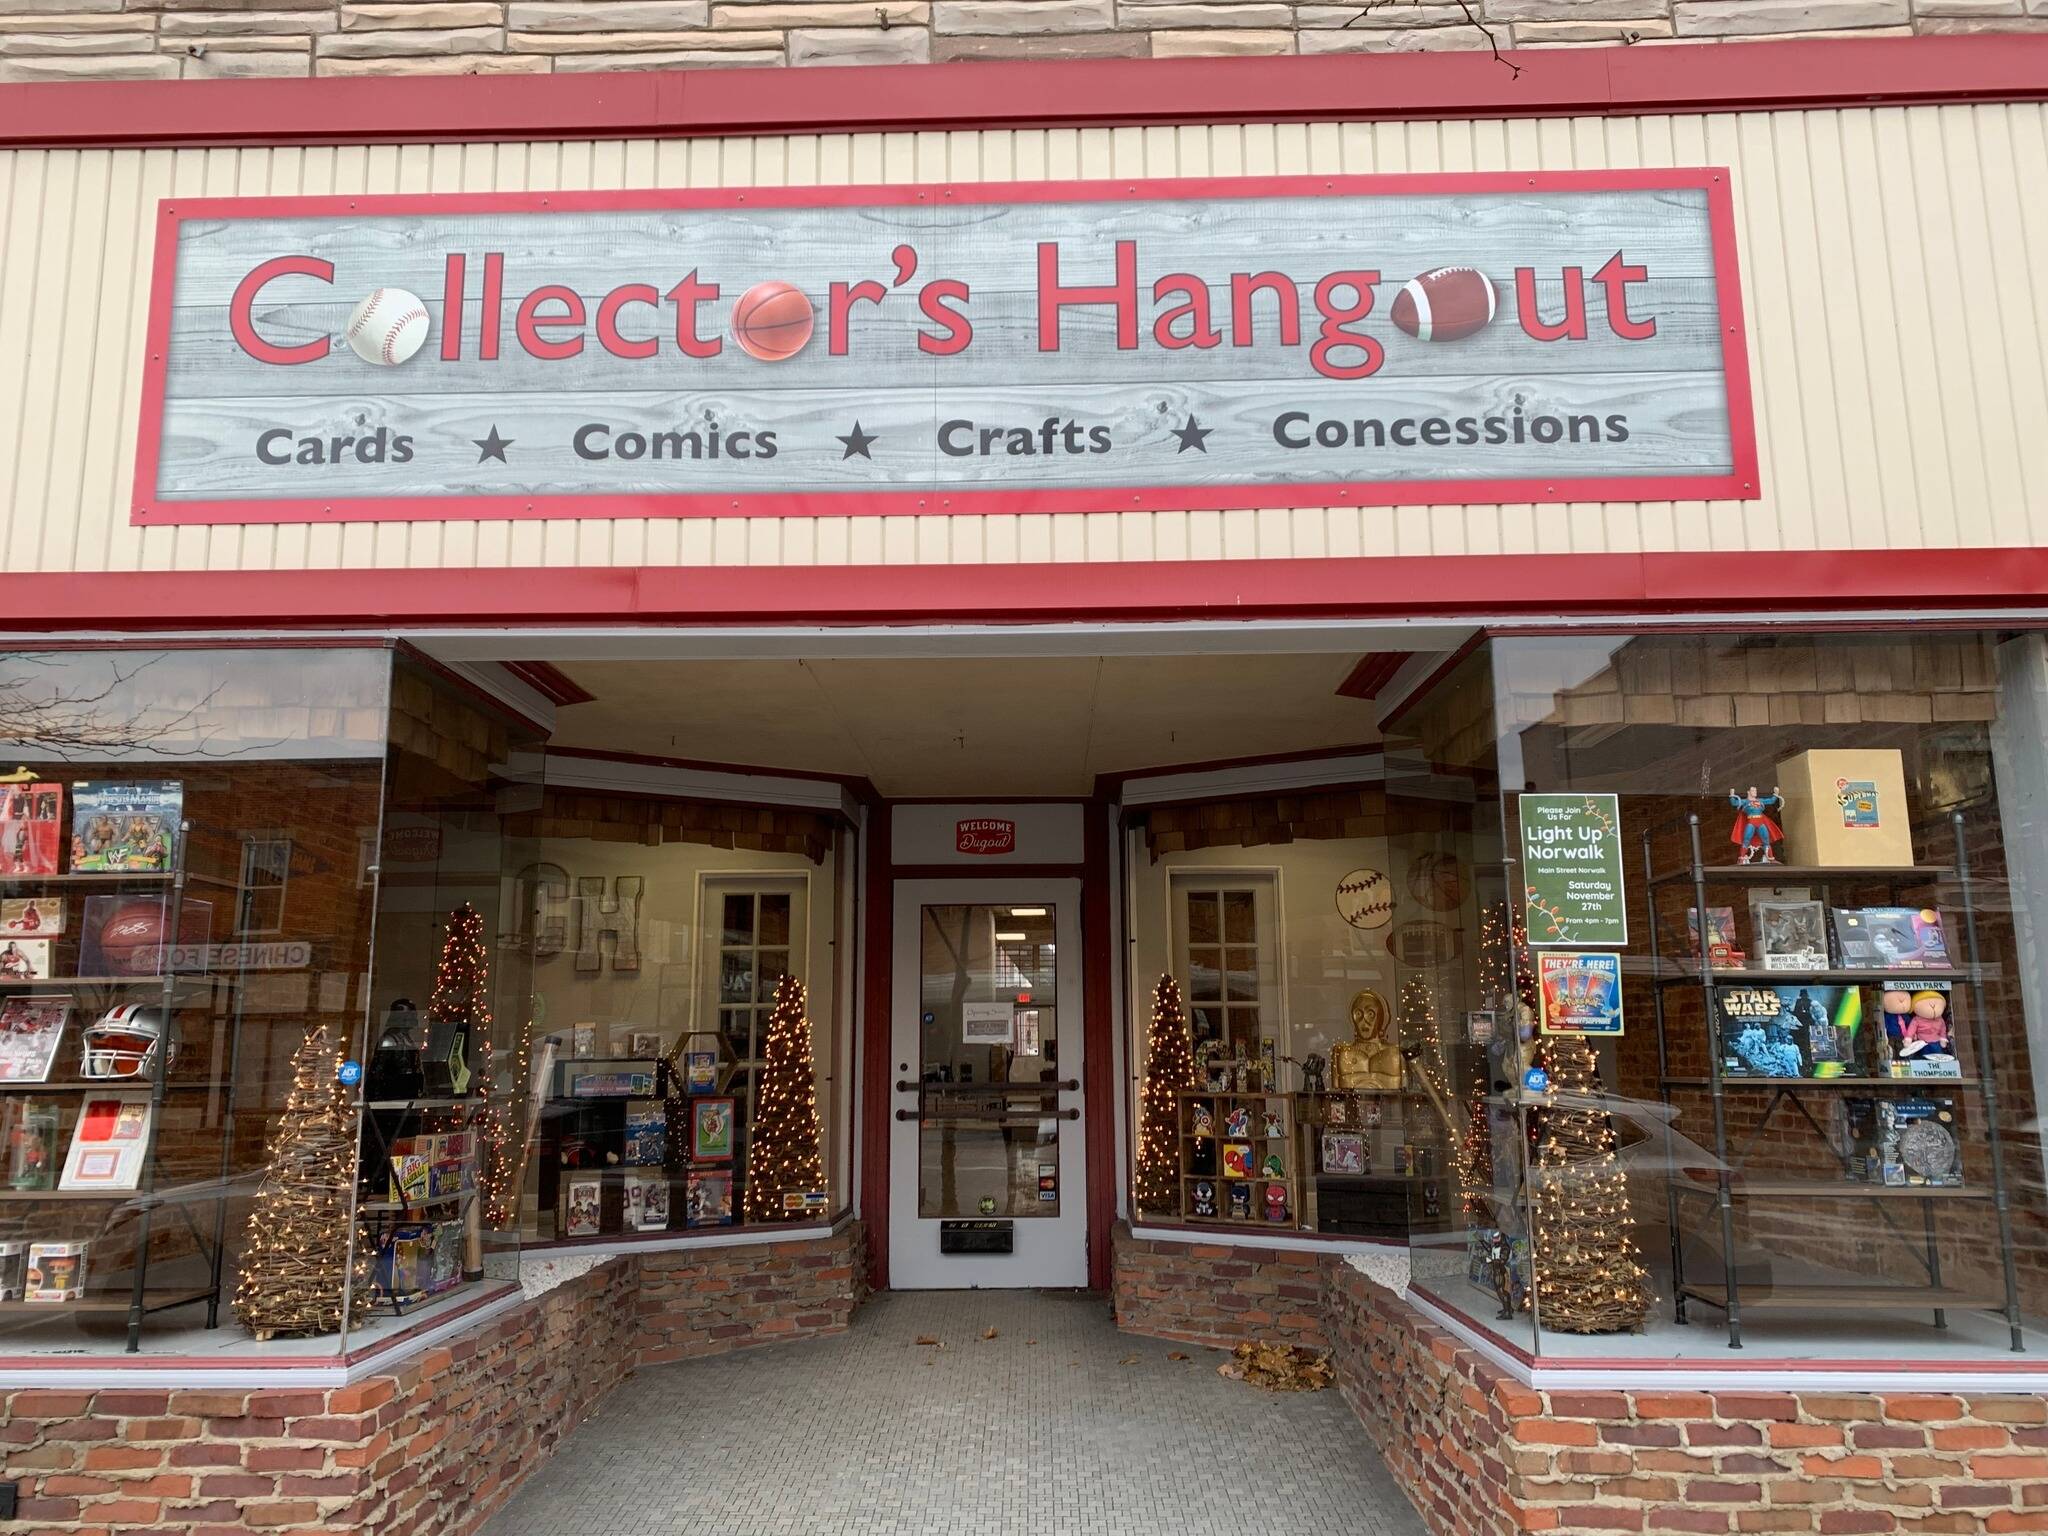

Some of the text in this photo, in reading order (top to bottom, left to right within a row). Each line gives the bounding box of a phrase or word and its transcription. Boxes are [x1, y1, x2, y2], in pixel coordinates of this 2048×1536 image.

[256, 405, 1630, 466] Cards Comics Crafts Concessions
[1537, 806, 1581, 814] Please Join
[1547, 813, 1558, 821] Us
[960, 821, 1012, 832] WELCOME
[1527, 825, 1603, 844] Light Up
[960, 833, 1011, 852] Dugout
[1528, 844, 1605, 859] Norwalk
[1568, 880, 1611, 891] Saturday
[1566, 891, 1615, 900] November
[1581, 902, 1602, 911] 27th
[1584, 917, 1599, 925] 4pm
[1605, 917, 1619, 925] 7pm
[1544, 959, 1615, 970] THEY'RE HERE!
[1723, 990, 1780, 1003] STAR
[1723, 1003, 1781, 1015] WARS
[342, 1067, 358, 1077] ADT
[1529, 1074, 1545, 1083] ADT
[406, 1159, 420, 1174] BIG
